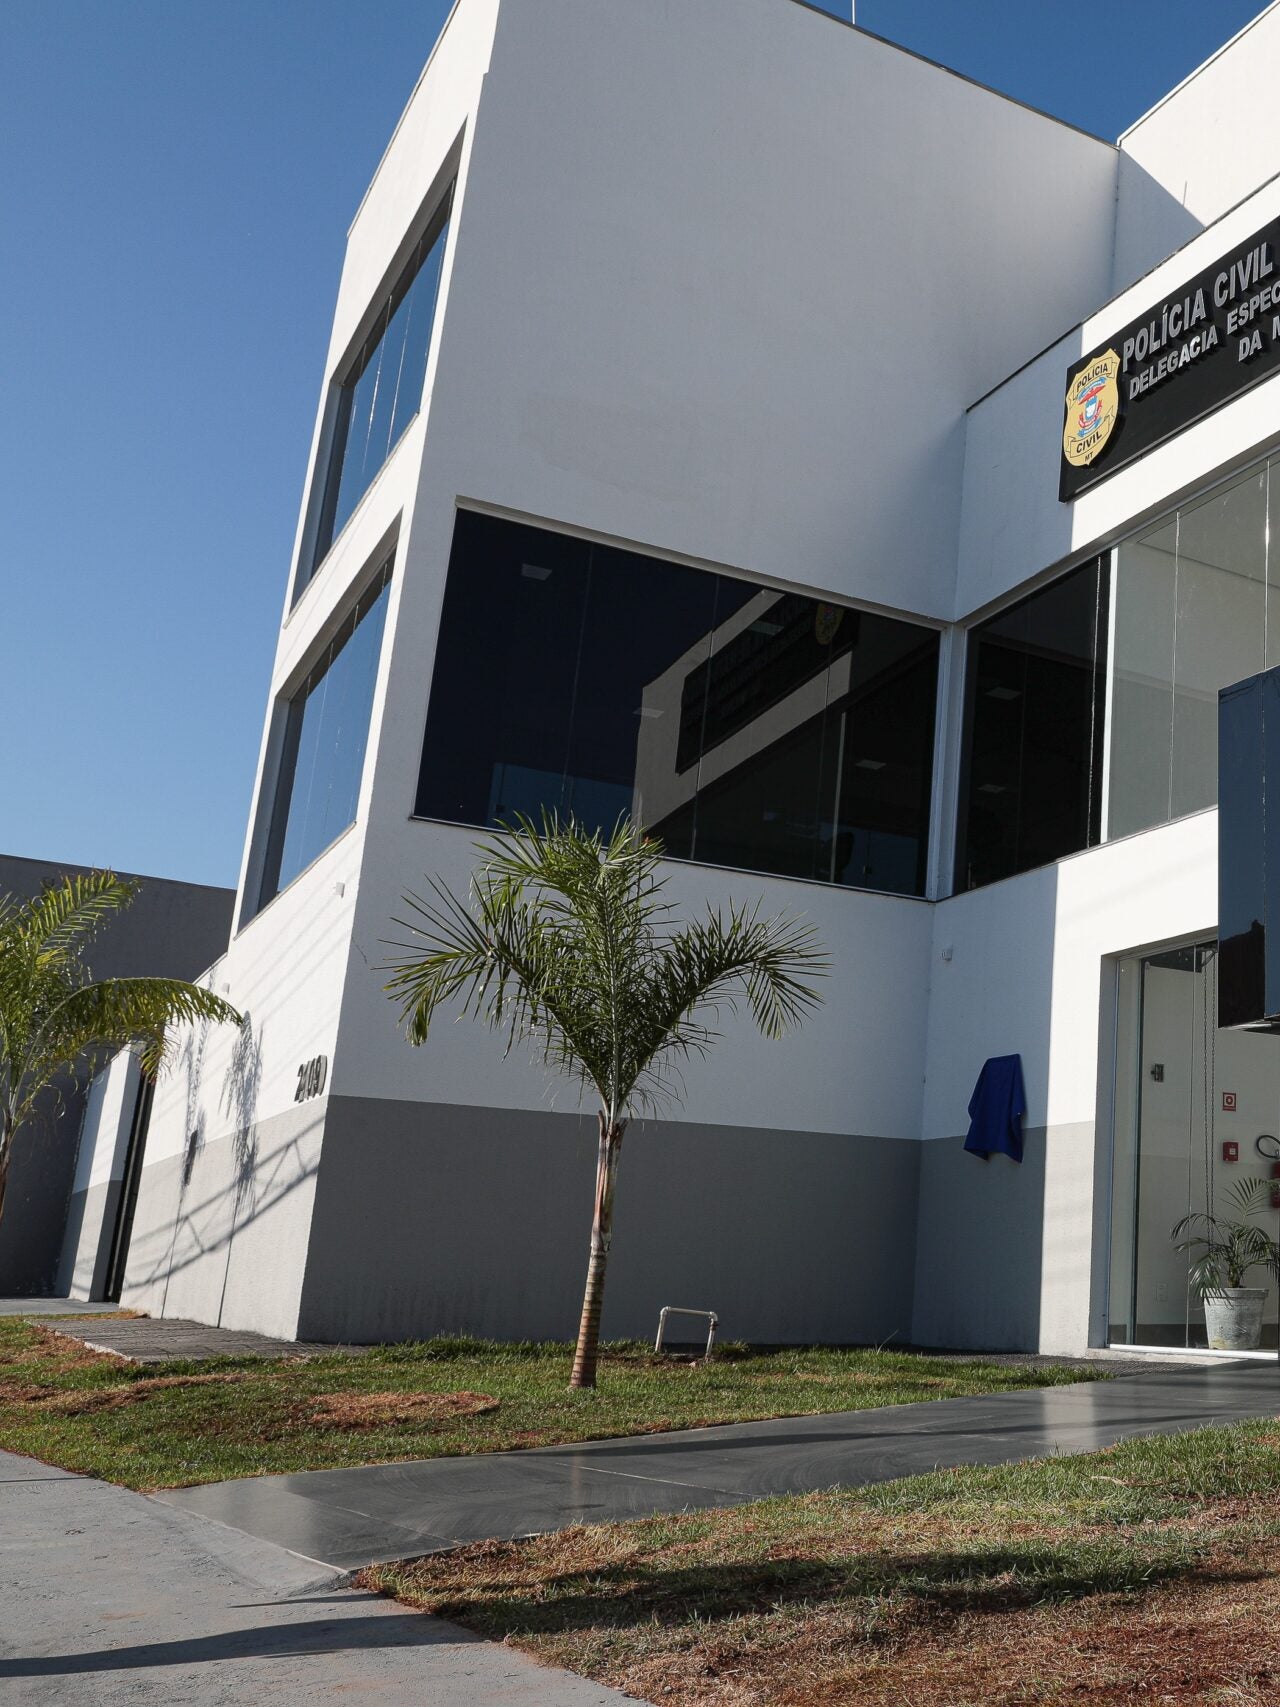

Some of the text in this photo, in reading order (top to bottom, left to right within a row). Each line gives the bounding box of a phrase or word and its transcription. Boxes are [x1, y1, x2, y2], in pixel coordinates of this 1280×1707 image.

[1123, 289, 1206, 372] POLÍCIA
[1214, 242, 1273, 308] CIVIL
[1130, 325, 1218, 400] DELEGACIA
[1238, 336, 1263, 362] DA
[1076, 362, 1108, 393] POLÍCIA
[1076, 431, 1102, 454] CIVIL
[1084, 451, 1094, 462] MT
